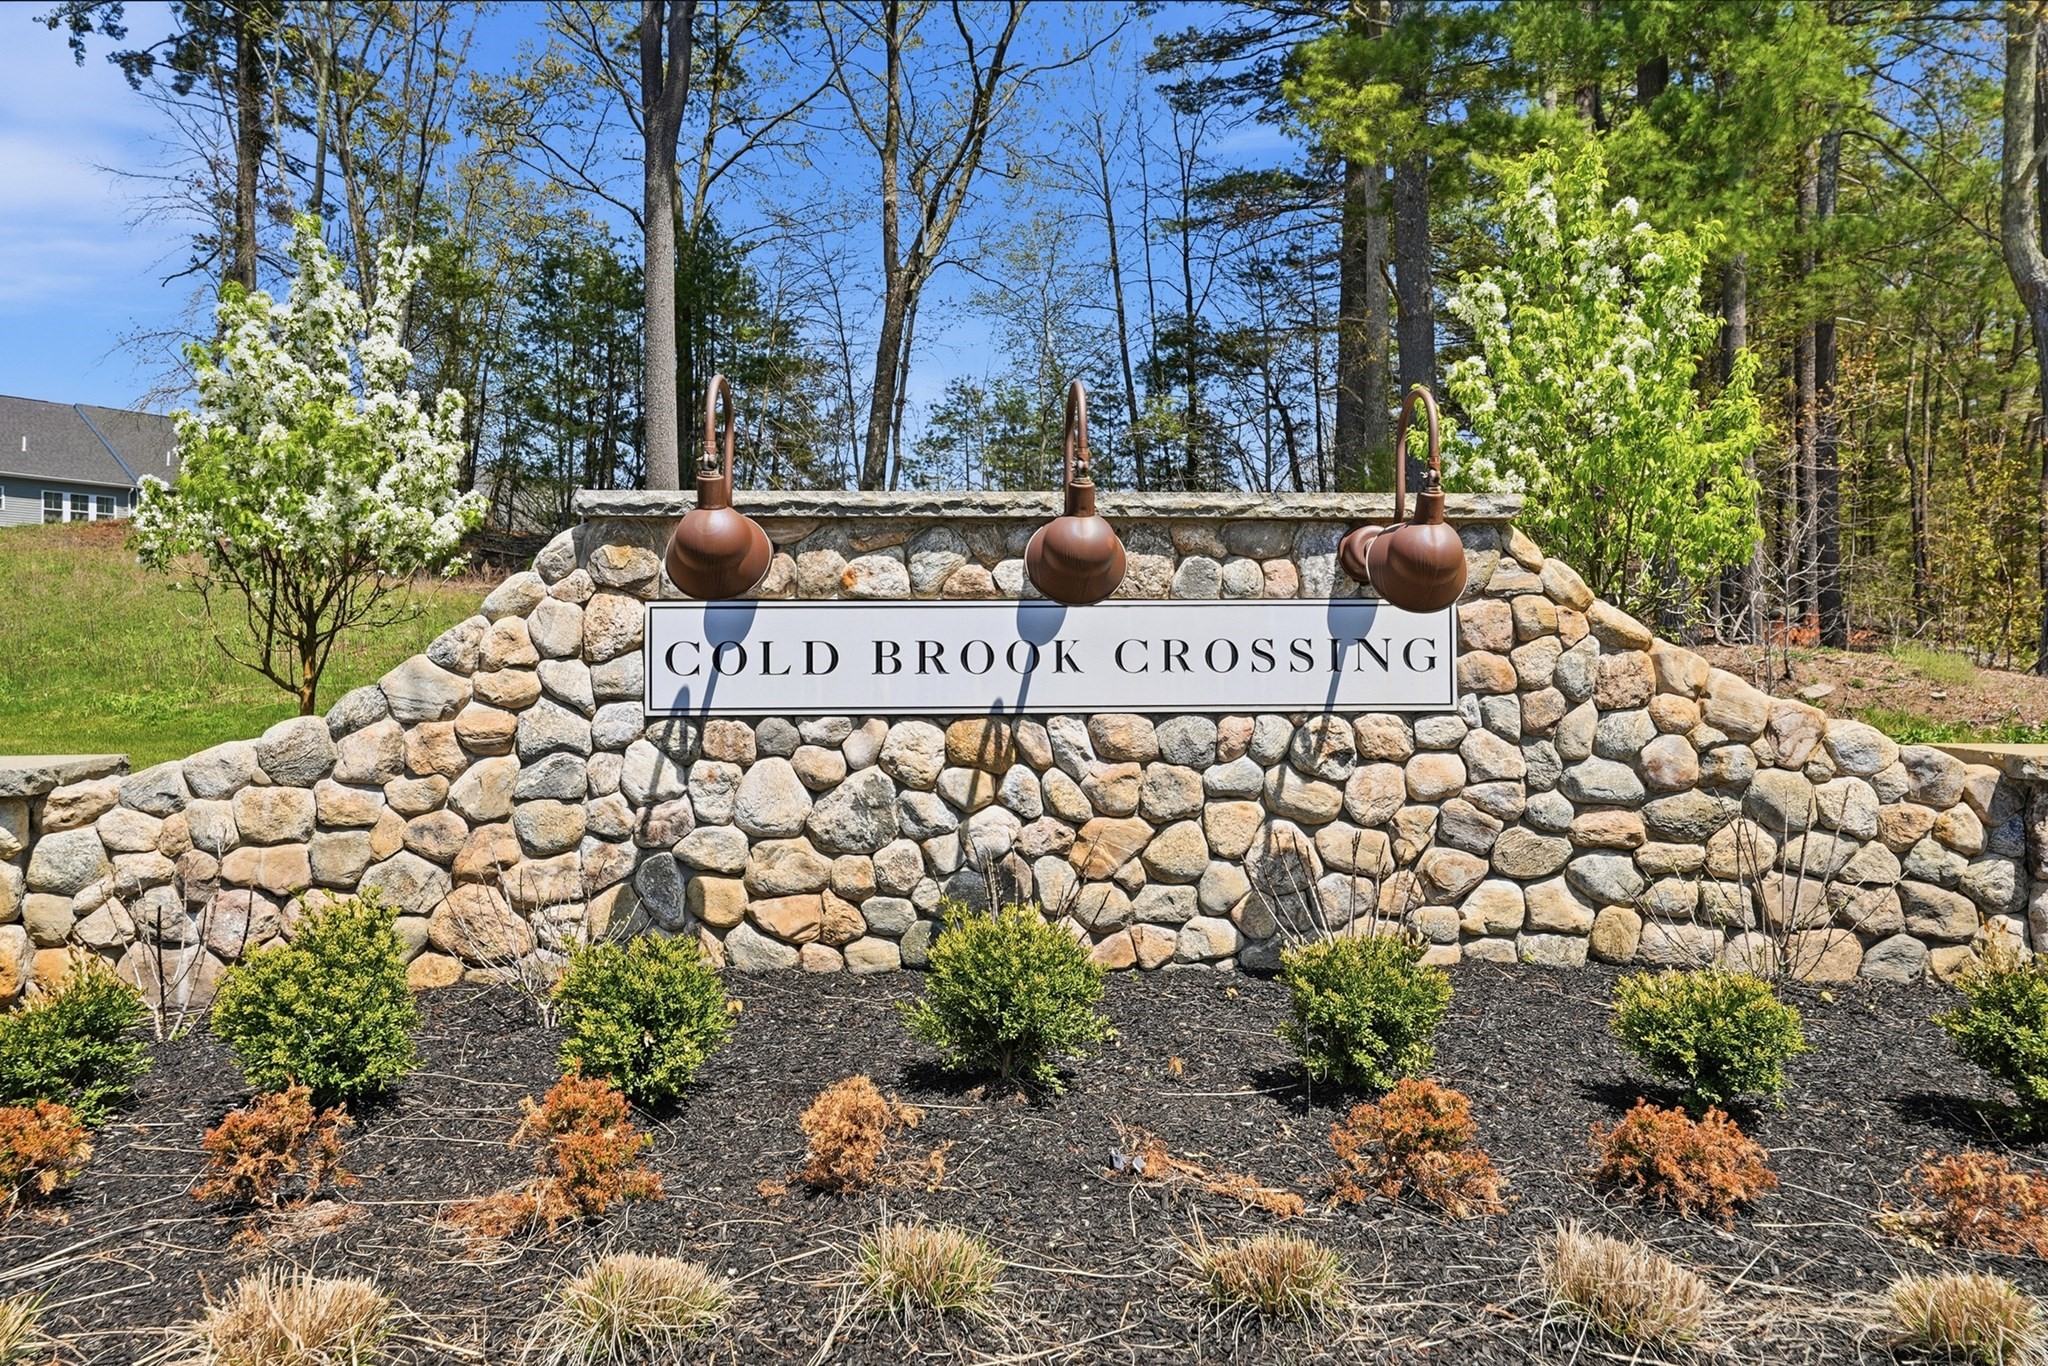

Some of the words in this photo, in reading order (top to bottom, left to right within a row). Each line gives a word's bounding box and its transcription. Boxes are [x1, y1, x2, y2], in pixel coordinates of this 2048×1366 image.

[665, 640, 839, 676] COLD
[871, 639, 1083, 676] BROOK
[1115, 638, 1438, 673] CROSSING
